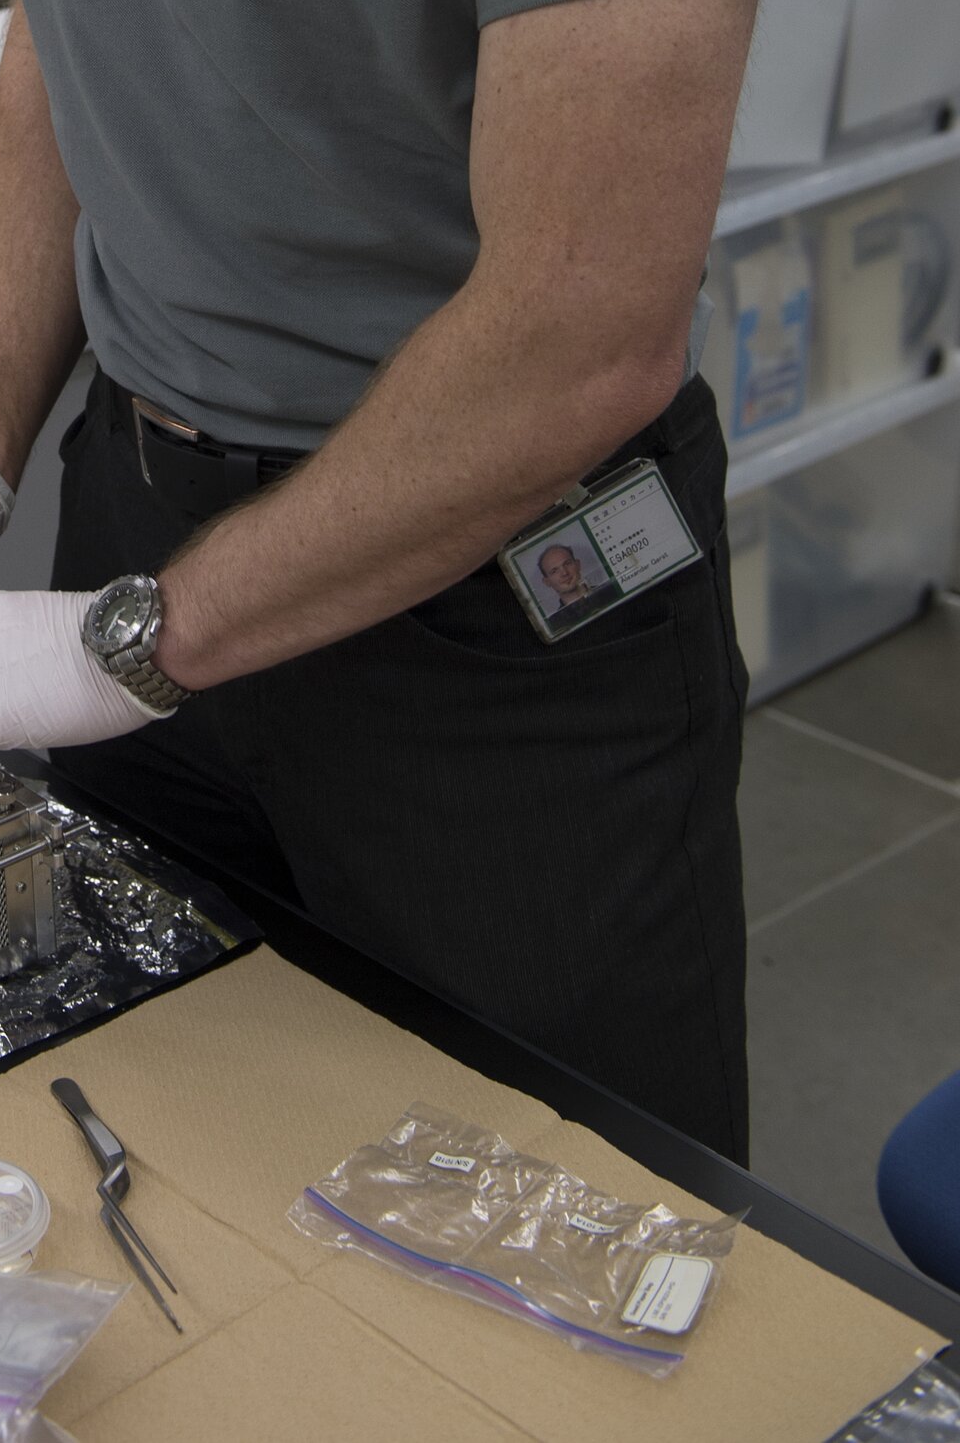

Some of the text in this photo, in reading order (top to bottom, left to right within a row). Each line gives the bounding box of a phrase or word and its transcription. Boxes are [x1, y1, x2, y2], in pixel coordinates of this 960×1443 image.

[609, 536, 650, 566] ESA0020
[621, 563, 650, 584] Alexander
[650, 552, 669, 566] Gerst
